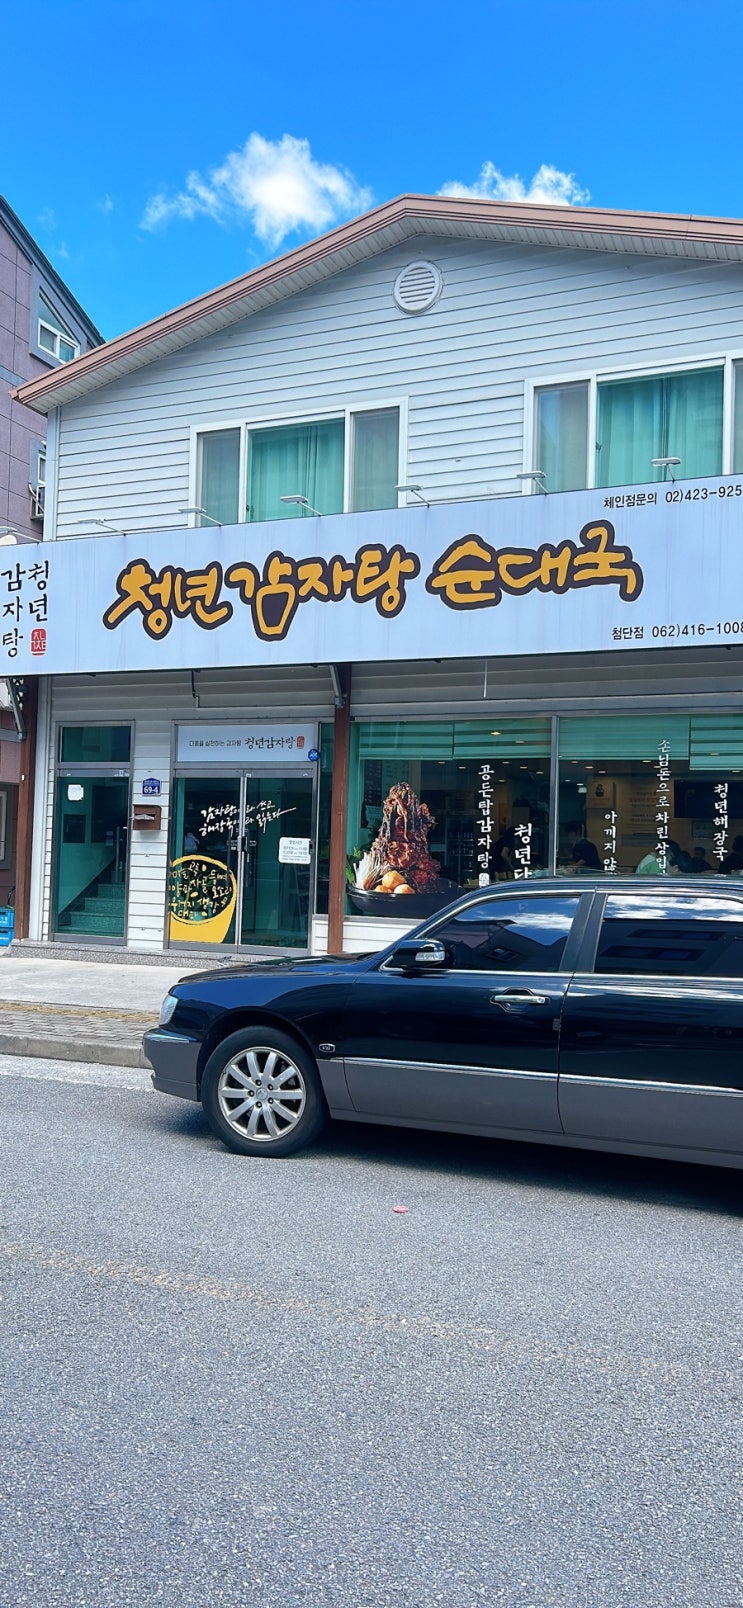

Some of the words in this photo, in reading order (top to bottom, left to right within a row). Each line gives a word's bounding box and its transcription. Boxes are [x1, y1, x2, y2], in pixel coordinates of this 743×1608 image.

[603, 492, 657, 508] 체인점문의
[665, 485, 743, 503] 02)423-925
[427, 522, 641, 608] 순대국
[1, 563, 26, 658] 감자탕
[28, 560, 49, 622] 청년
[612, 626, 644, 640] 첨단점
[244, 736, 296, 750] 청년감자탕
[143, 786, 159, 794] 69-4
[712, 782, 729, 862] 청년해장국
